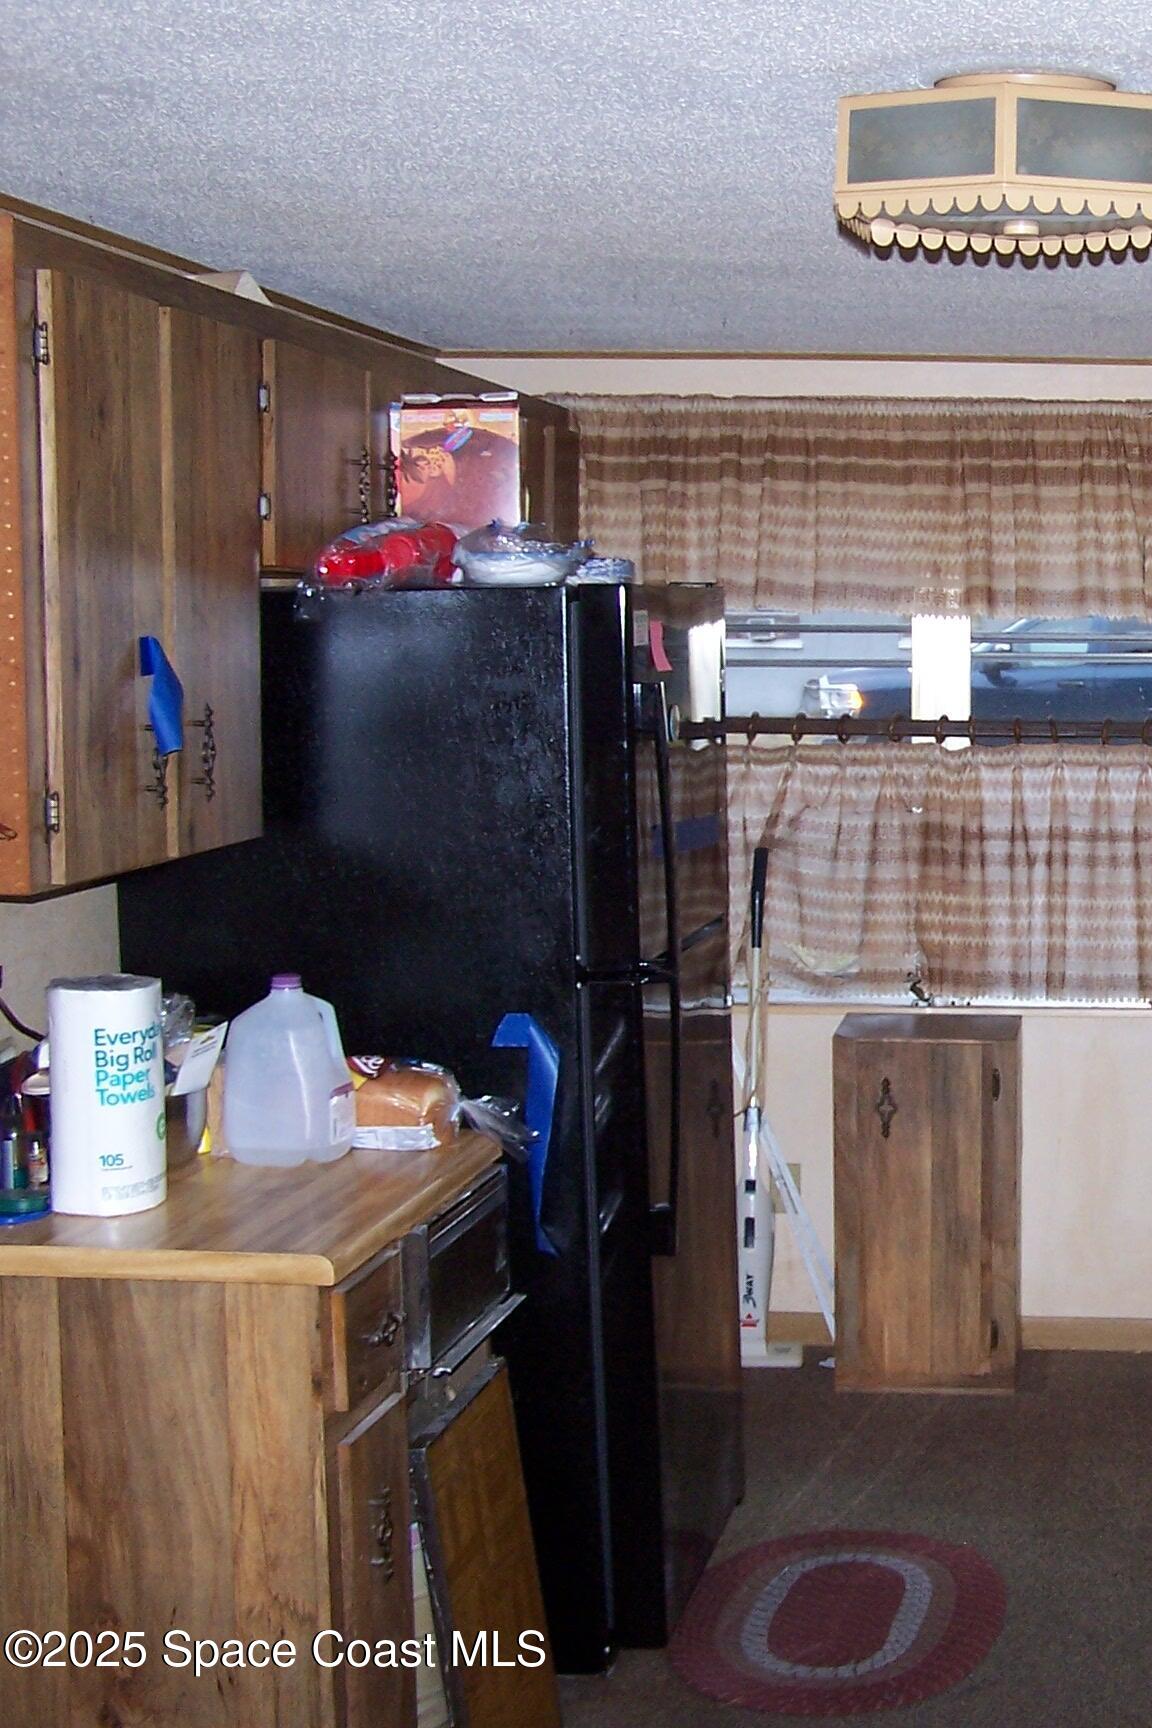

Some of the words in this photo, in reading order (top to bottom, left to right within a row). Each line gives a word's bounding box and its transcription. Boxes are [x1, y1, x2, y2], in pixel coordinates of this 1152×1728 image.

[95, 1049, 129, 1072] Big
[96, 1068, 151, 1091] Paper
[96, 1082, 156, 1107] Towels
[99, 1153, 124, 1167] 105
